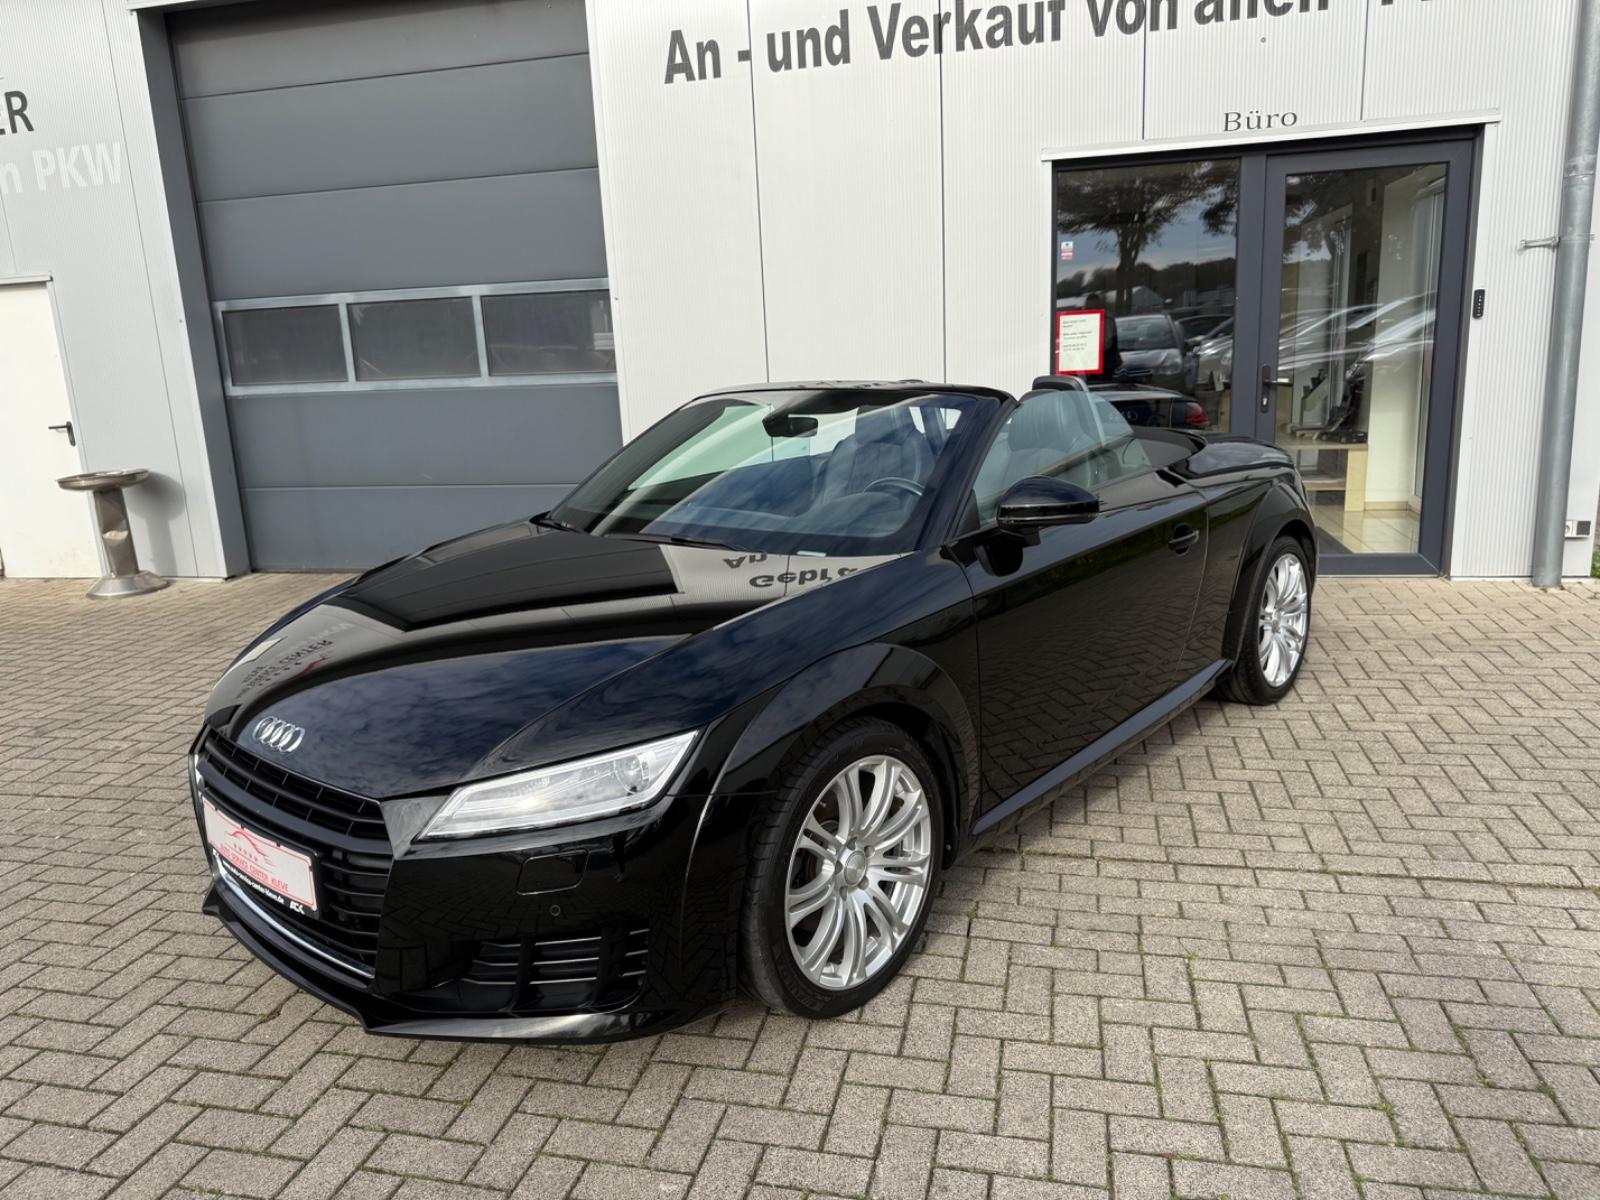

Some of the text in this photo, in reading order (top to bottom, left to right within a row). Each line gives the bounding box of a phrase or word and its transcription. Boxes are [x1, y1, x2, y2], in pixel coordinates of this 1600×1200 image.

[664, 29, 722, 85] An
[766, 9, 850, 73] und
[866, 0, 1066, 60] Verkauf
[1223, 110, 1298, 132] Büro
[32, 142, 122, 192] PKW
